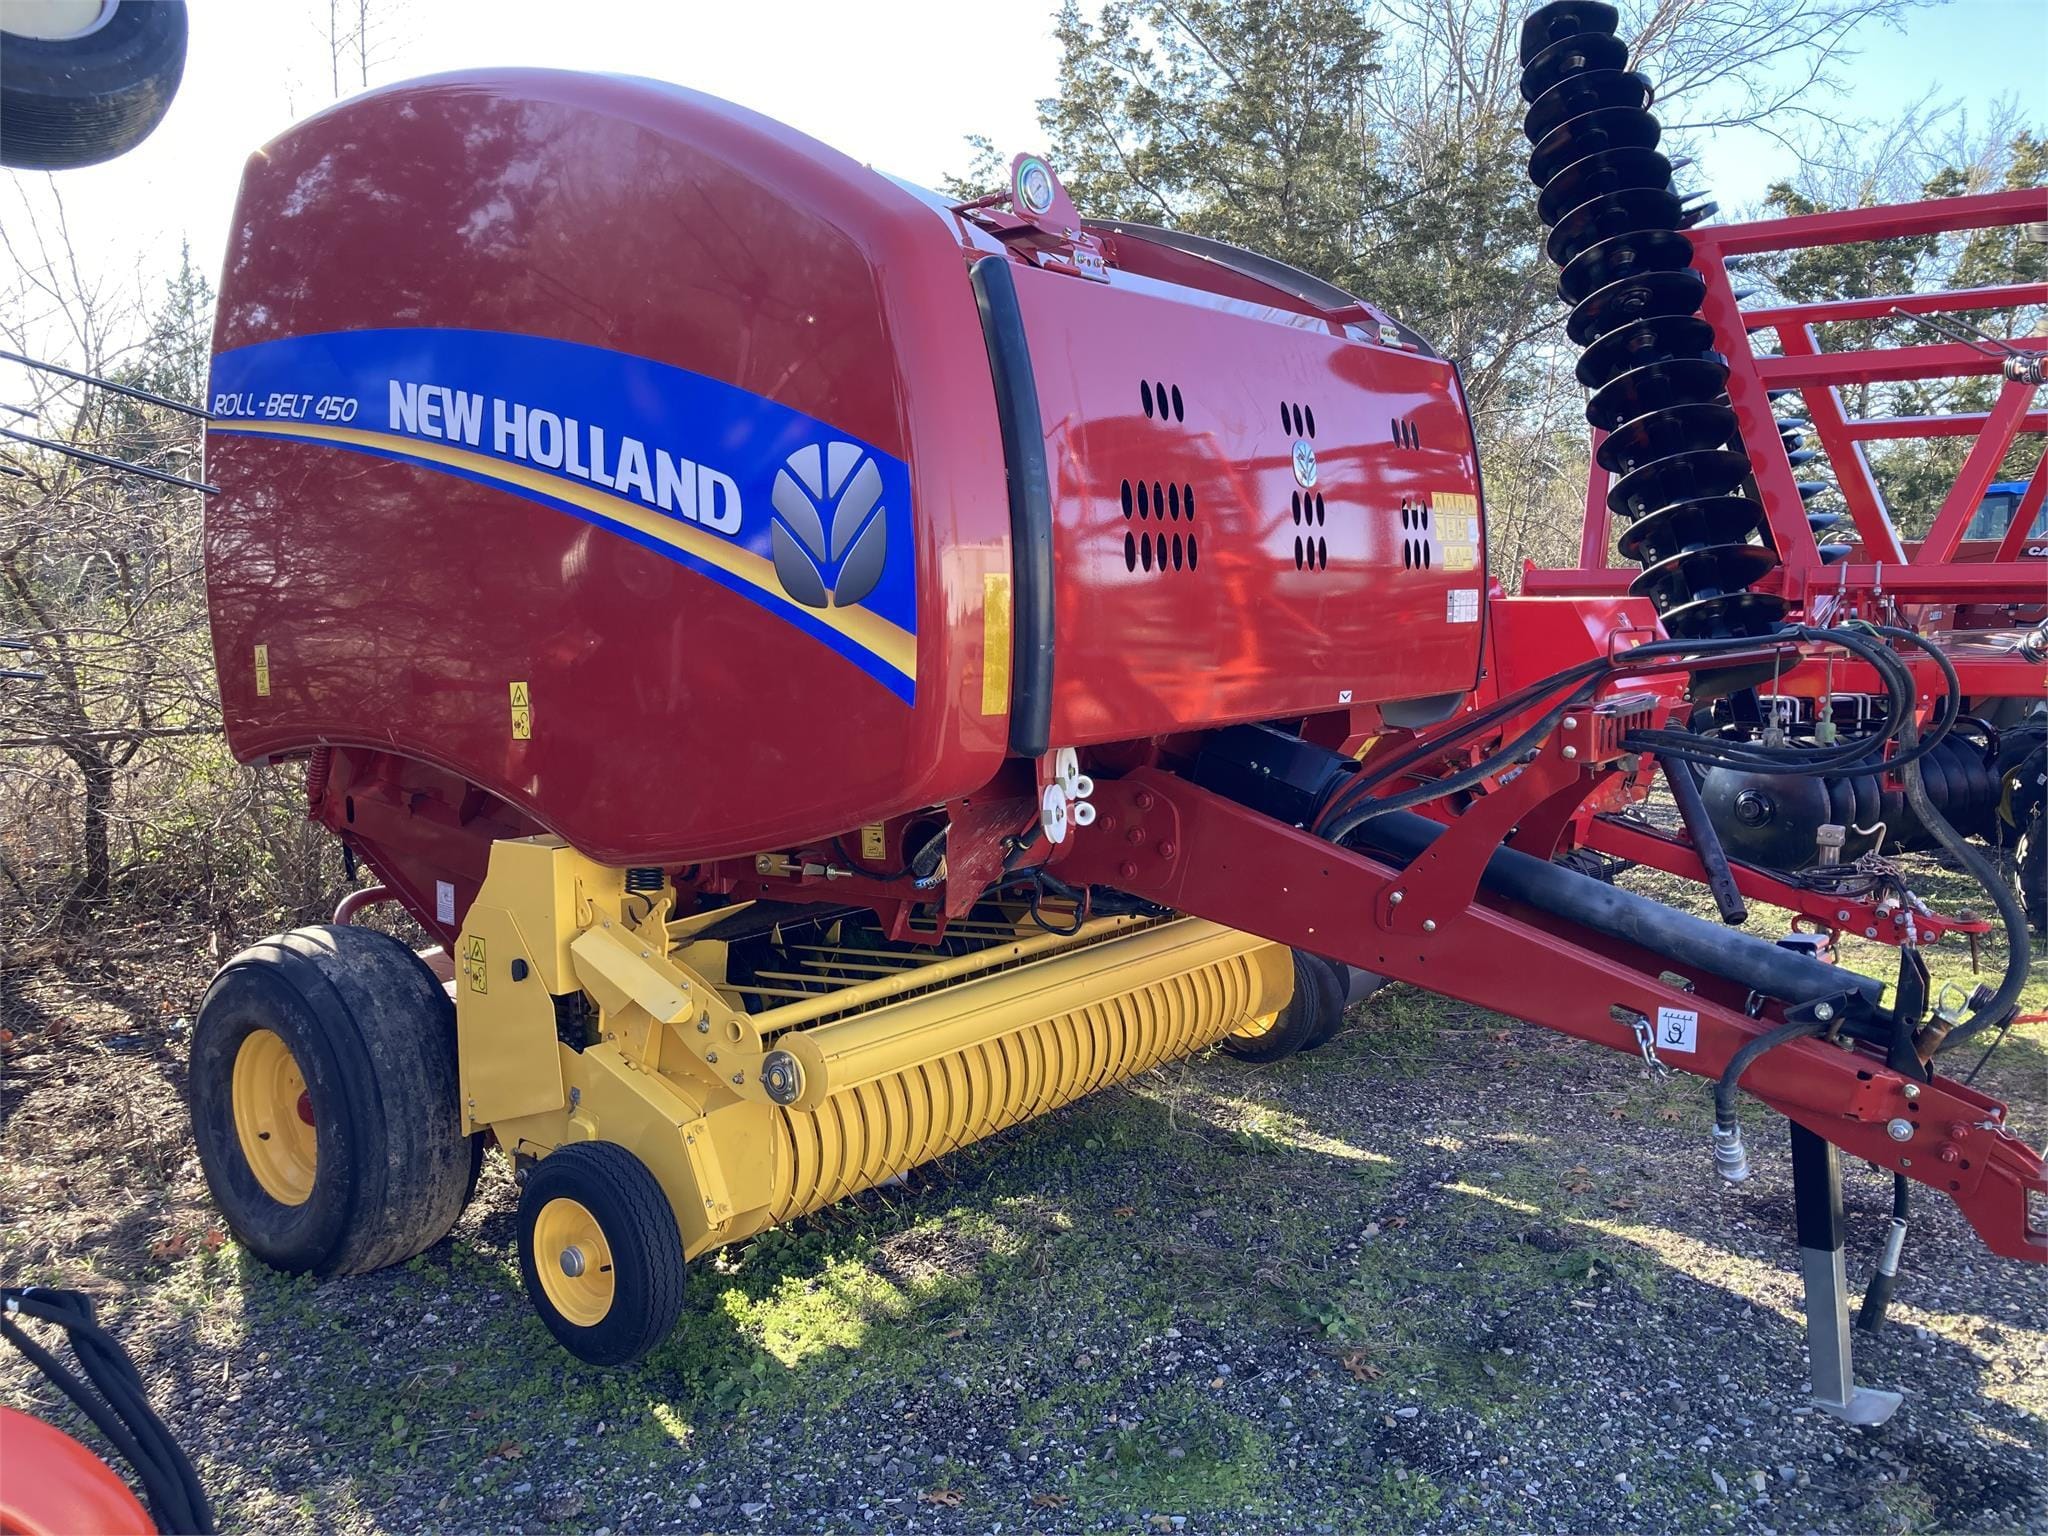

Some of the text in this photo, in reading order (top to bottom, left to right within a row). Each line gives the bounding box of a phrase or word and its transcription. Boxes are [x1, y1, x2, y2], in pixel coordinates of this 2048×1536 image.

[213, 392, 358, 422] ROLL-BELT 450
[389, 380, 743, 535] NEW HOLLAND
